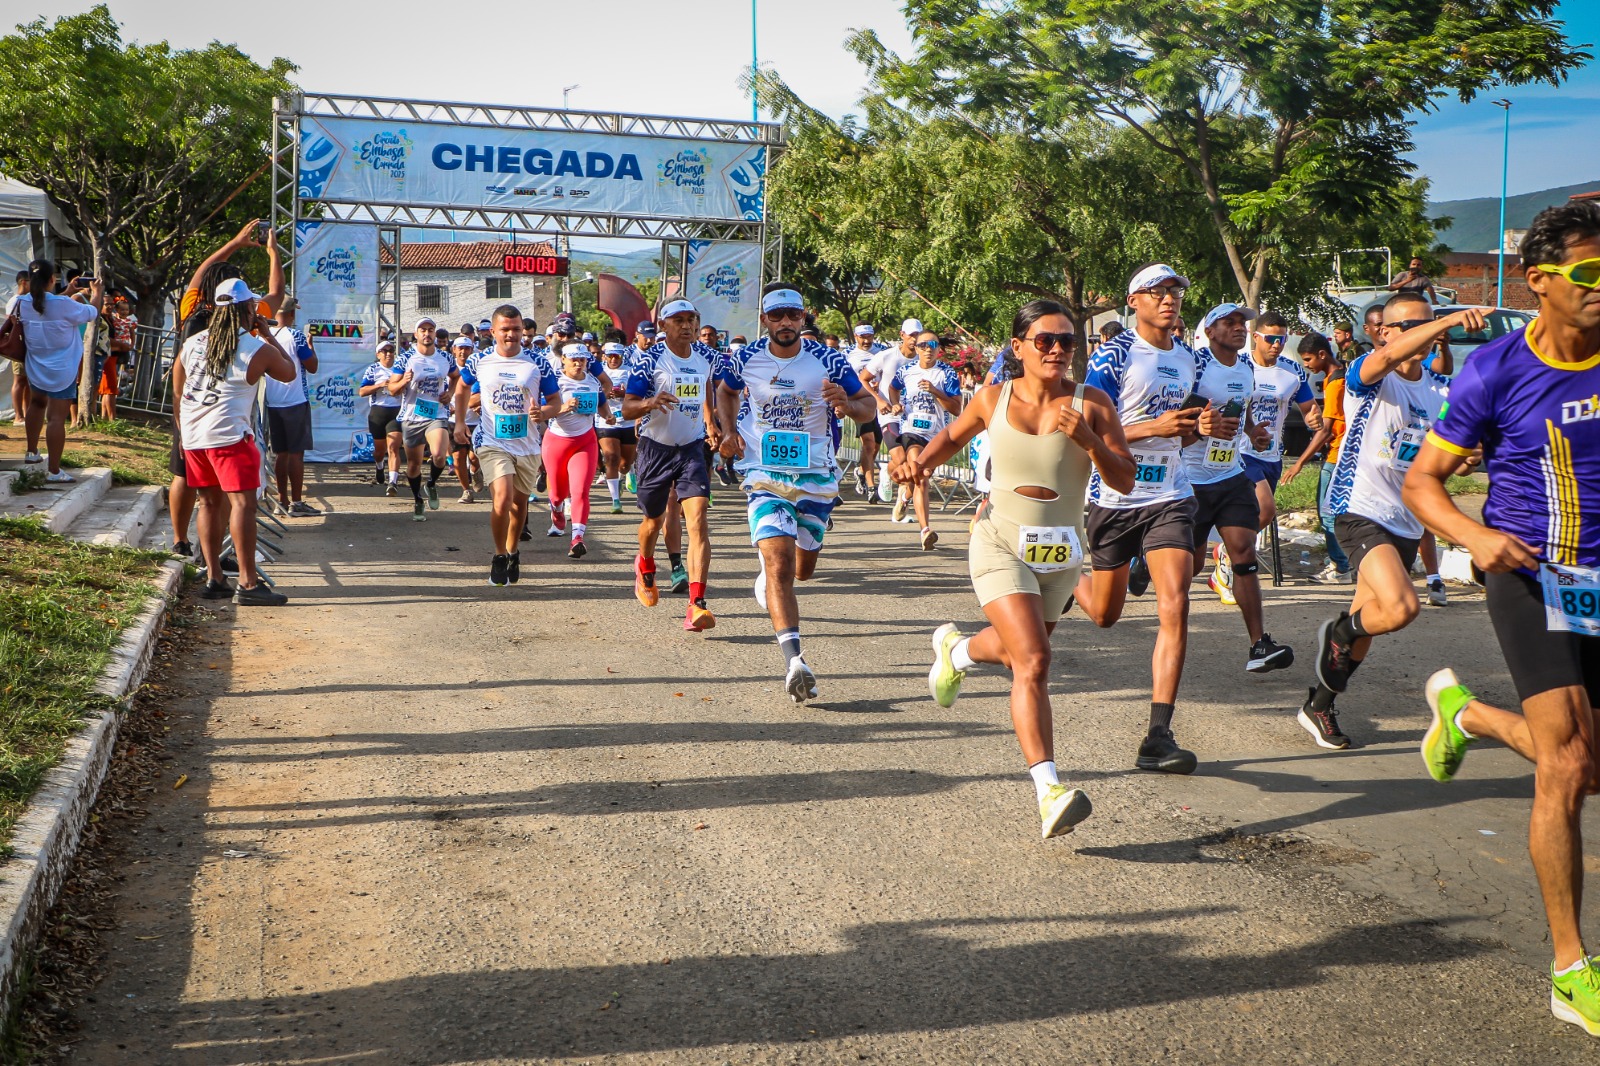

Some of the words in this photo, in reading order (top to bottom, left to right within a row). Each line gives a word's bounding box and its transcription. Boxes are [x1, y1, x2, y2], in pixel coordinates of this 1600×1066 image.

[360, 141, 404, 161] Embasa
[373, 157, 405, 170] Corrida
[431, 143, 643, 181] CHEGADA
[664, 159, 704, 178] Embasa
[391, 170, 405, 178] 2025
[676, 174, 705, 186] Corrida
[316, 257, 355, 273] Embasa
[328, 270, 355, 281] Corrida
[705, 273, 740, 289] Embasa
[309, 324, 363, 338] BAHIA
[316, 385, 354, 401] Embasa
[676, 384, 698, 396] 144
[327, 397, 355, 409] Corrida
[492, 390, 524, 404] Embasa
[419, 406, 434, 415] 593
[578, 400, 593, 409] 536
[762, 403, 803, 420] Embasa
[501, 424, 521, 433] 598
[773, 417, 804, 428] Corrida
[912, 419, 930, 429] 839
[770, 445, 799, 458] 595
[1211, 449, 1233, 462] 131
[1027, 545, 1067, 562] 178
[1559, 576, 1572, 585] 5K
[1562, 590, 1600, 617] 89
